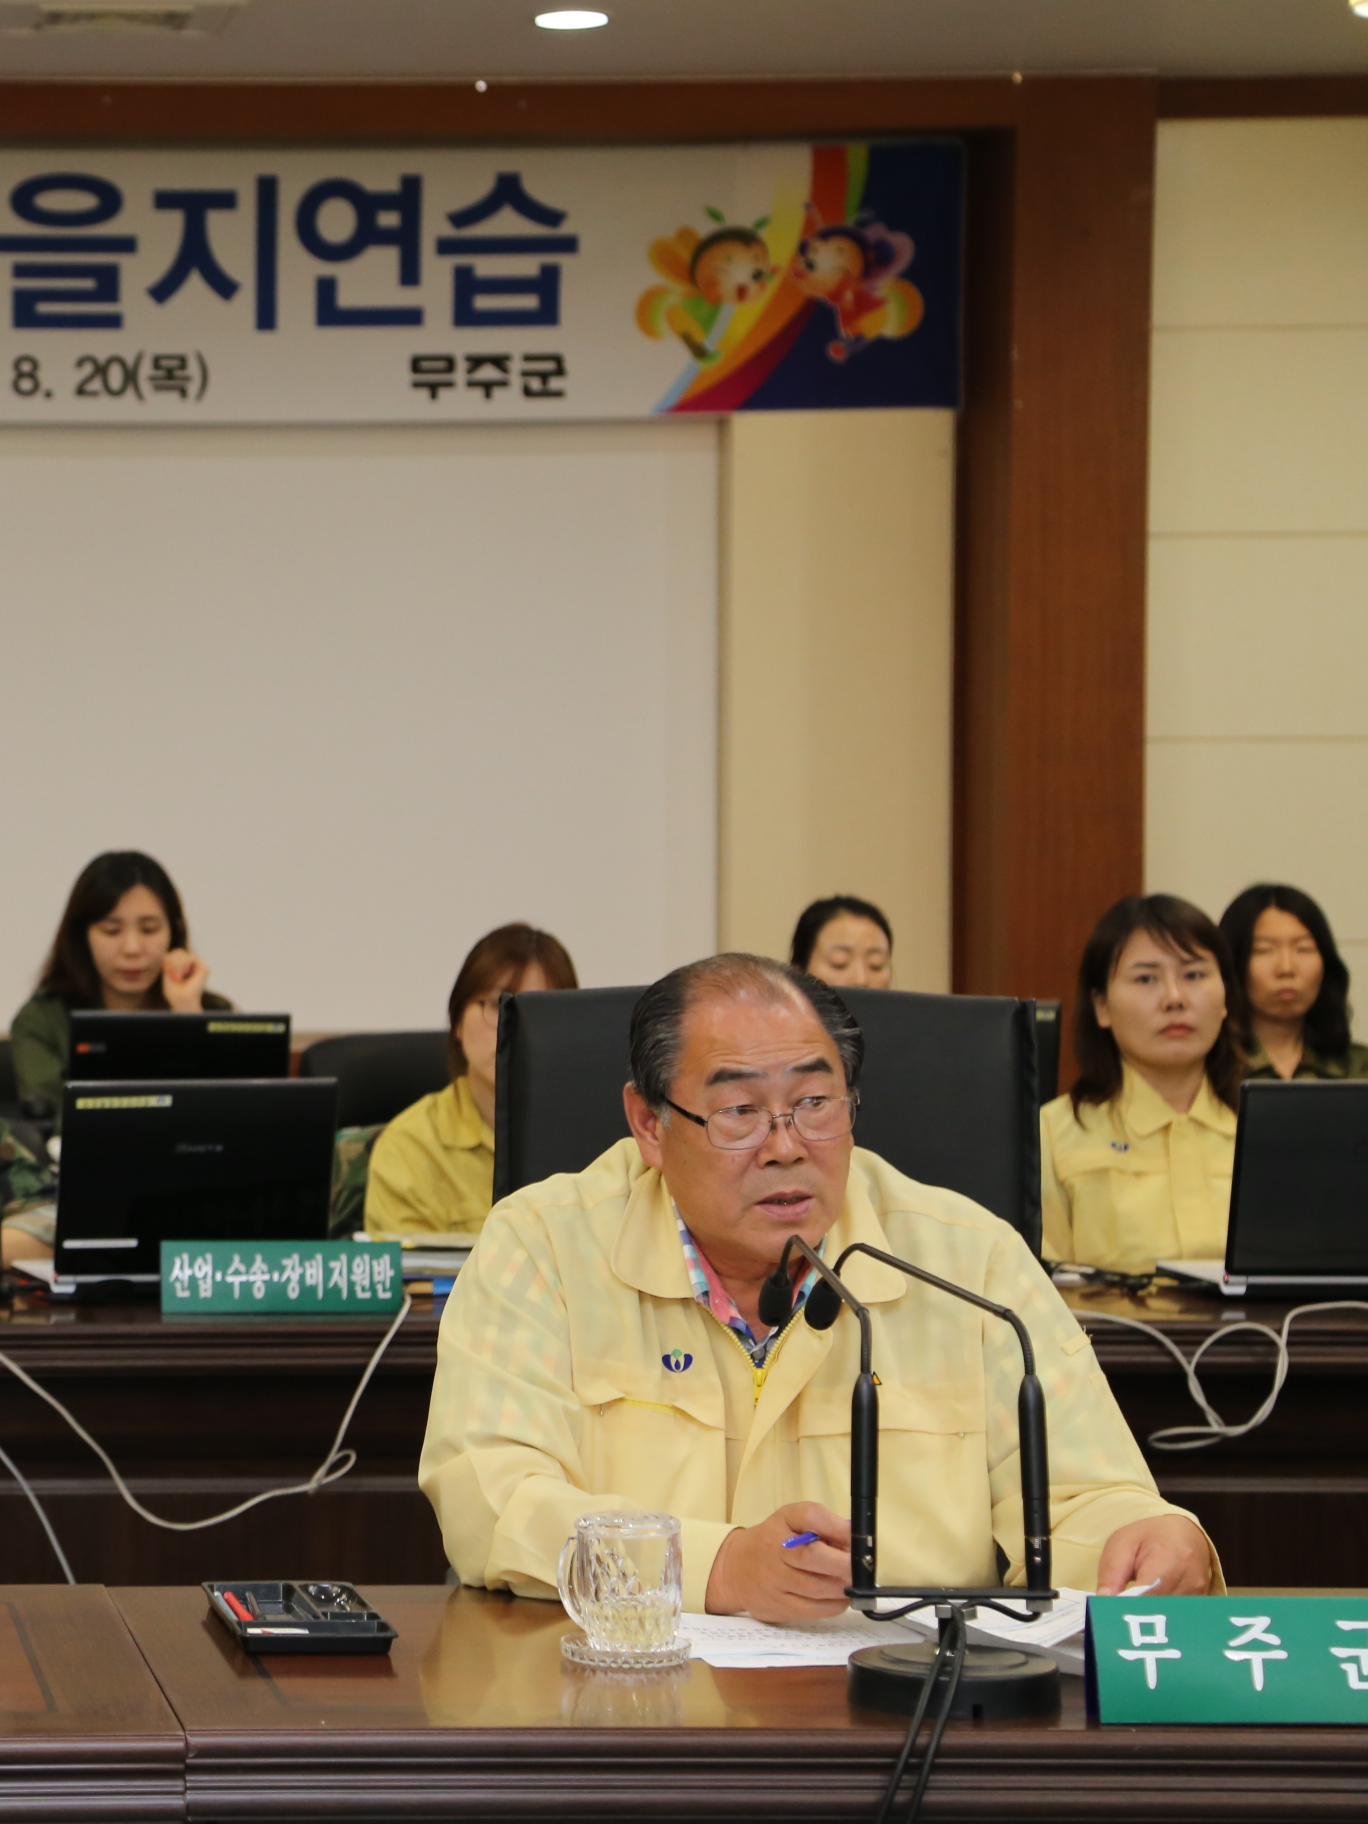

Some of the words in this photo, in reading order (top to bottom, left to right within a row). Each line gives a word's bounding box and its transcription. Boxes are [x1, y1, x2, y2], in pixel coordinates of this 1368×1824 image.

[11, 353, 53, 399] 8.
[74, 351, 209, 401] 20(목)
[409, 352, 567, 401] 무주군
